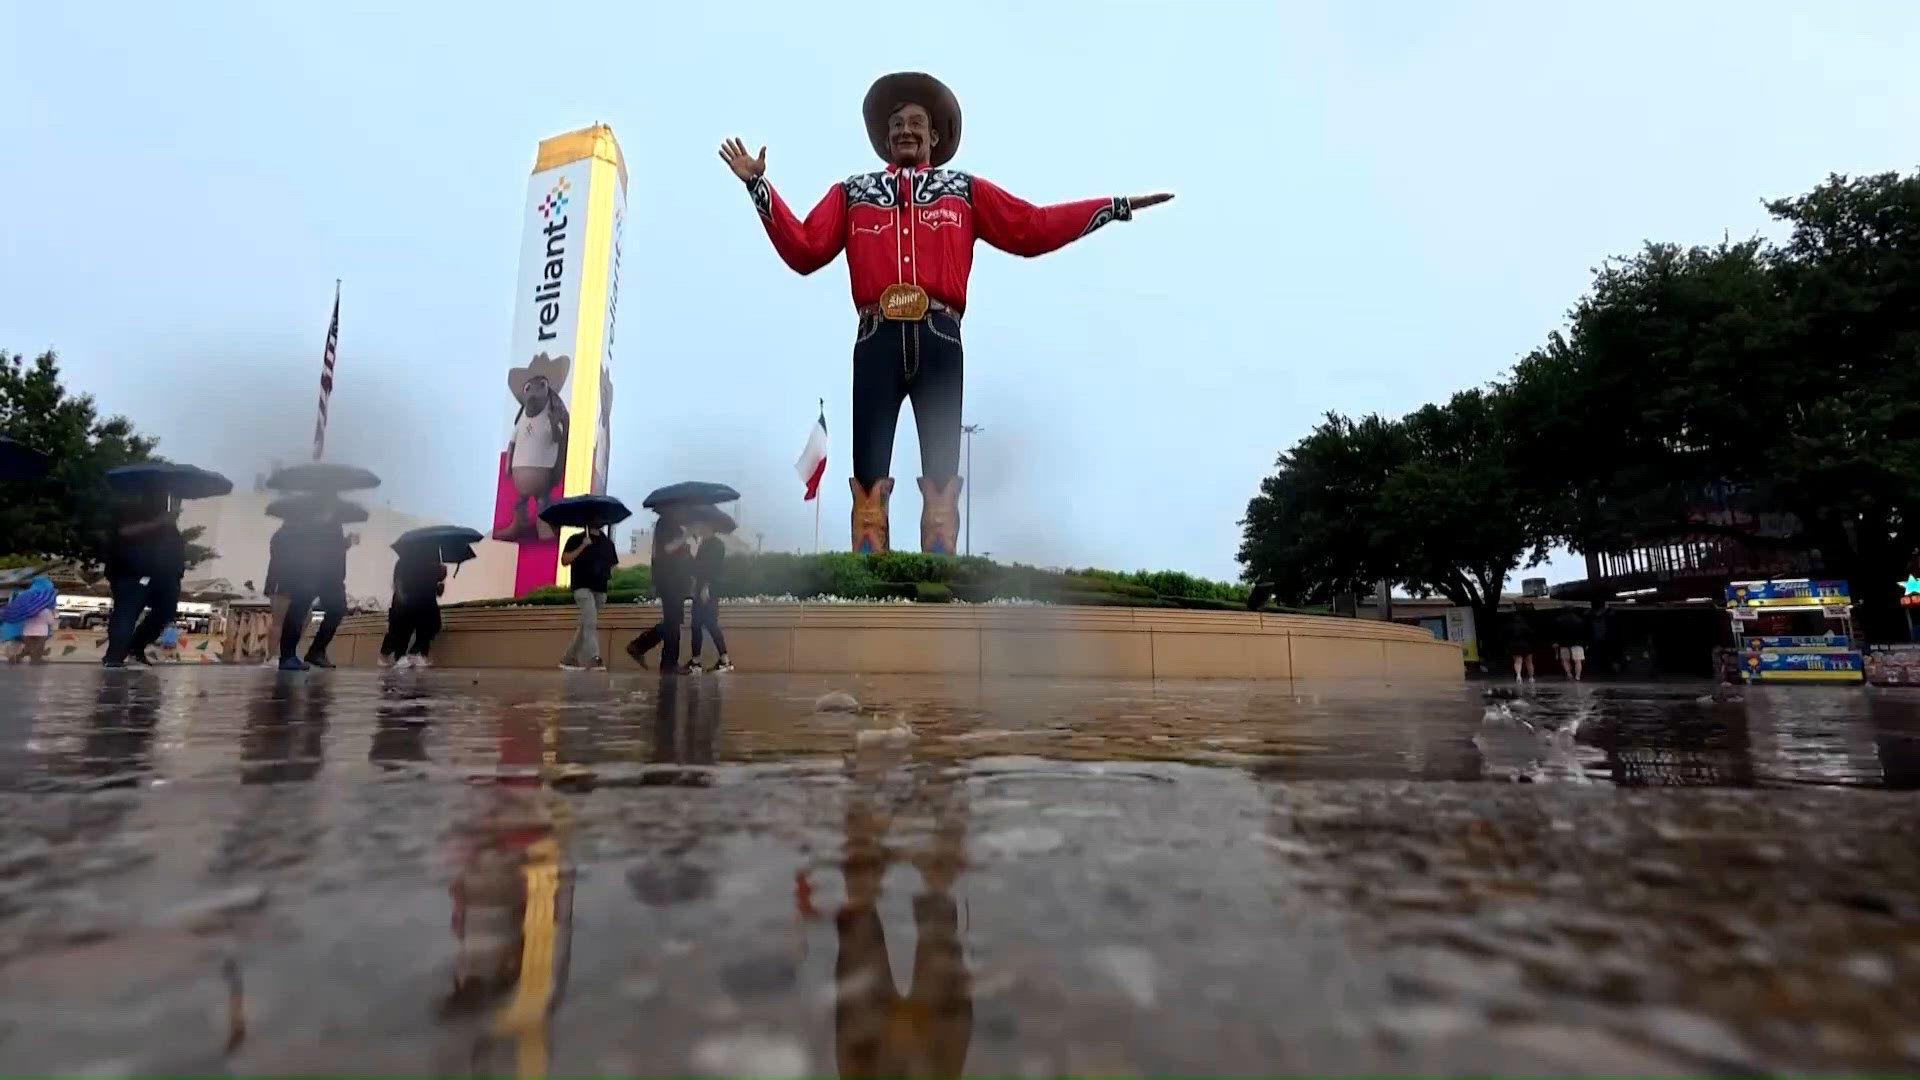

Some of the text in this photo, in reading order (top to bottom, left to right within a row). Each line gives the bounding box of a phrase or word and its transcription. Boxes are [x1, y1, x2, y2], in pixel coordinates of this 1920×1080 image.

[535, 215, 568, 342] reliant
[887, 292, 921, 309] Shiner
[1817, 587, 1840, 597] TEX
[1832, 660, 1853, 670] TEX
